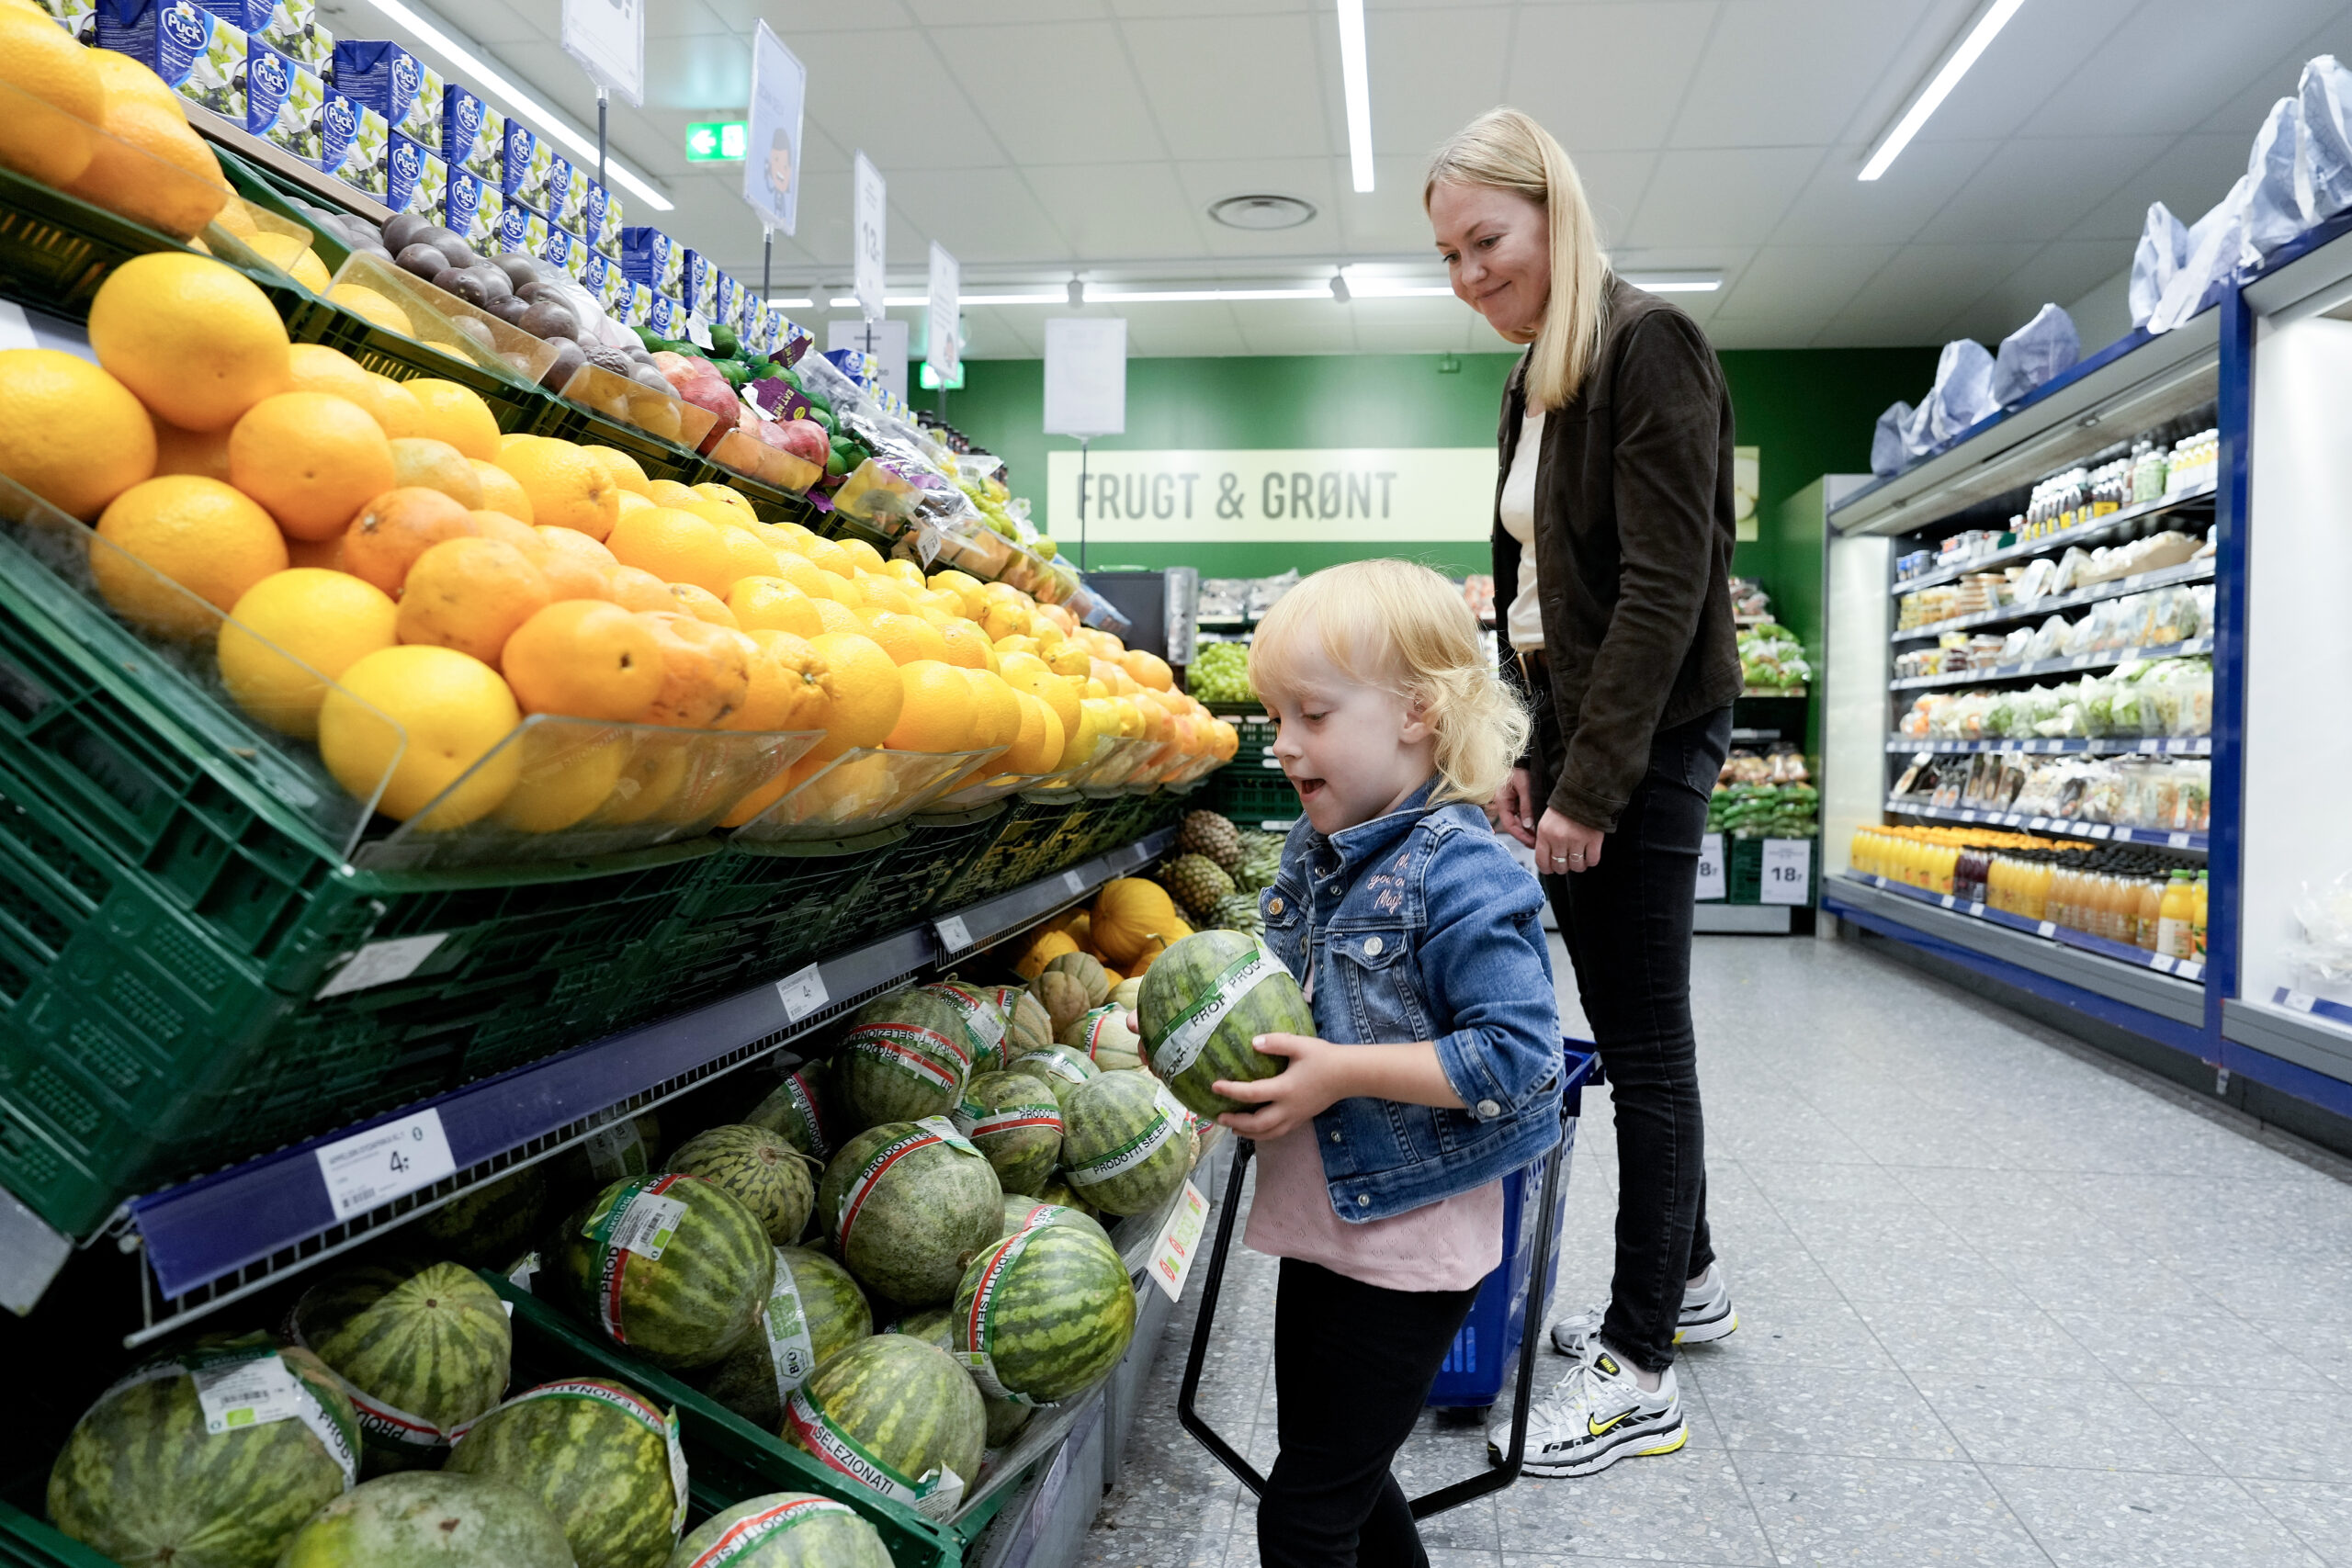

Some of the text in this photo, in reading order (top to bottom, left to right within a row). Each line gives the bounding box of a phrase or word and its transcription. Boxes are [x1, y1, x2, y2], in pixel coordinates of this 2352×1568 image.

[167, 14, 202, 43] Puck
[257, 62, 285, 90] Puck
[395, 62, 417, 88] Puck
[328, 108, 354, 133] Puck
[460, 105, 478, 125] Puck
[514, 137, 530, 156] Puck
[397, 152, 417, 175] Puck
[457, 186, 475, 206] Puck
[505, 214, 523, 233] Puck
[781, 388, 795, 406] EAT
[773, 403, 785, 417] ME
[1077, 470, 1397, 521] FRUGT & GRØNT
[862, 1133, 920, 1181] PRODOTTI
[1093, 1145, 1143, 1175] PRODOTTI
[606, 1195, 633, 1233] ØKOLOGI
[1600, 1358, 1617, 1374] NIKE
[815, 1425, 895, 1495] SELEZIONATI
